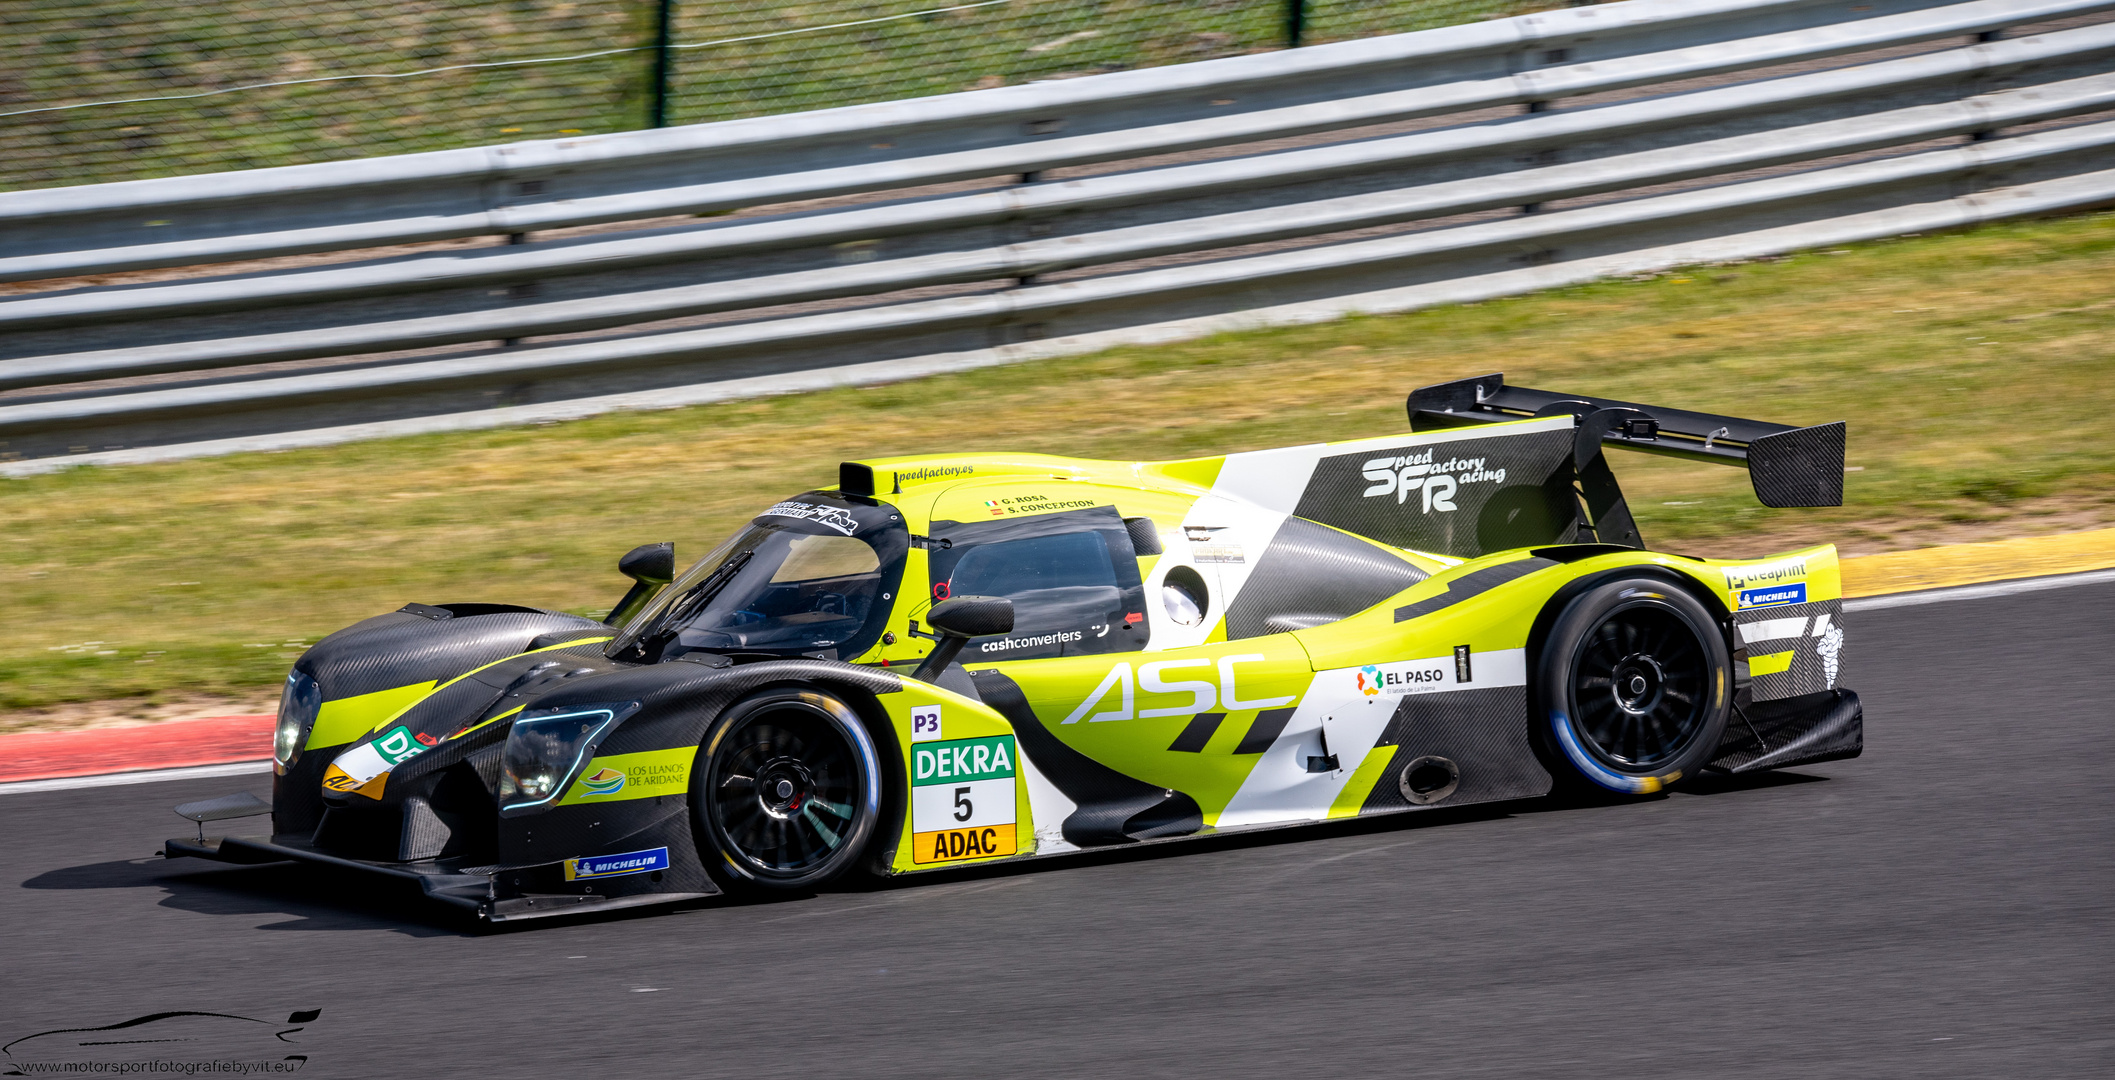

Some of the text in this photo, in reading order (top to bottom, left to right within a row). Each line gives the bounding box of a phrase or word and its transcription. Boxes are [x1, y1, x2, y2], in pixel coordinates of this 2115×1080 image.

[897, 465, 974, 483] peedfactory.es
[1008, 500, 1095, 514] S. CONCEPCION
[1015, 495, 1048, 503] ROSA
[1753, 590, 1799, 603] MICHELIN
[981, 630, 1082, 652] cashconverters
[1386, 669, 1443, 685] EL PASO
[1060, 653, 1297, 724] ASC
[914, 713, 938, 733] P3
[916, 742, 1012, 779] DEKRA
[628, 763, 684, 776] LOS LLANOS
[628, 774, 684, 787] DE ARIDANE
[953, 786, 973, 822] 5
[933, 828, 997, 859] ADAC
[595, 856, 657, 872] MICHELIN
